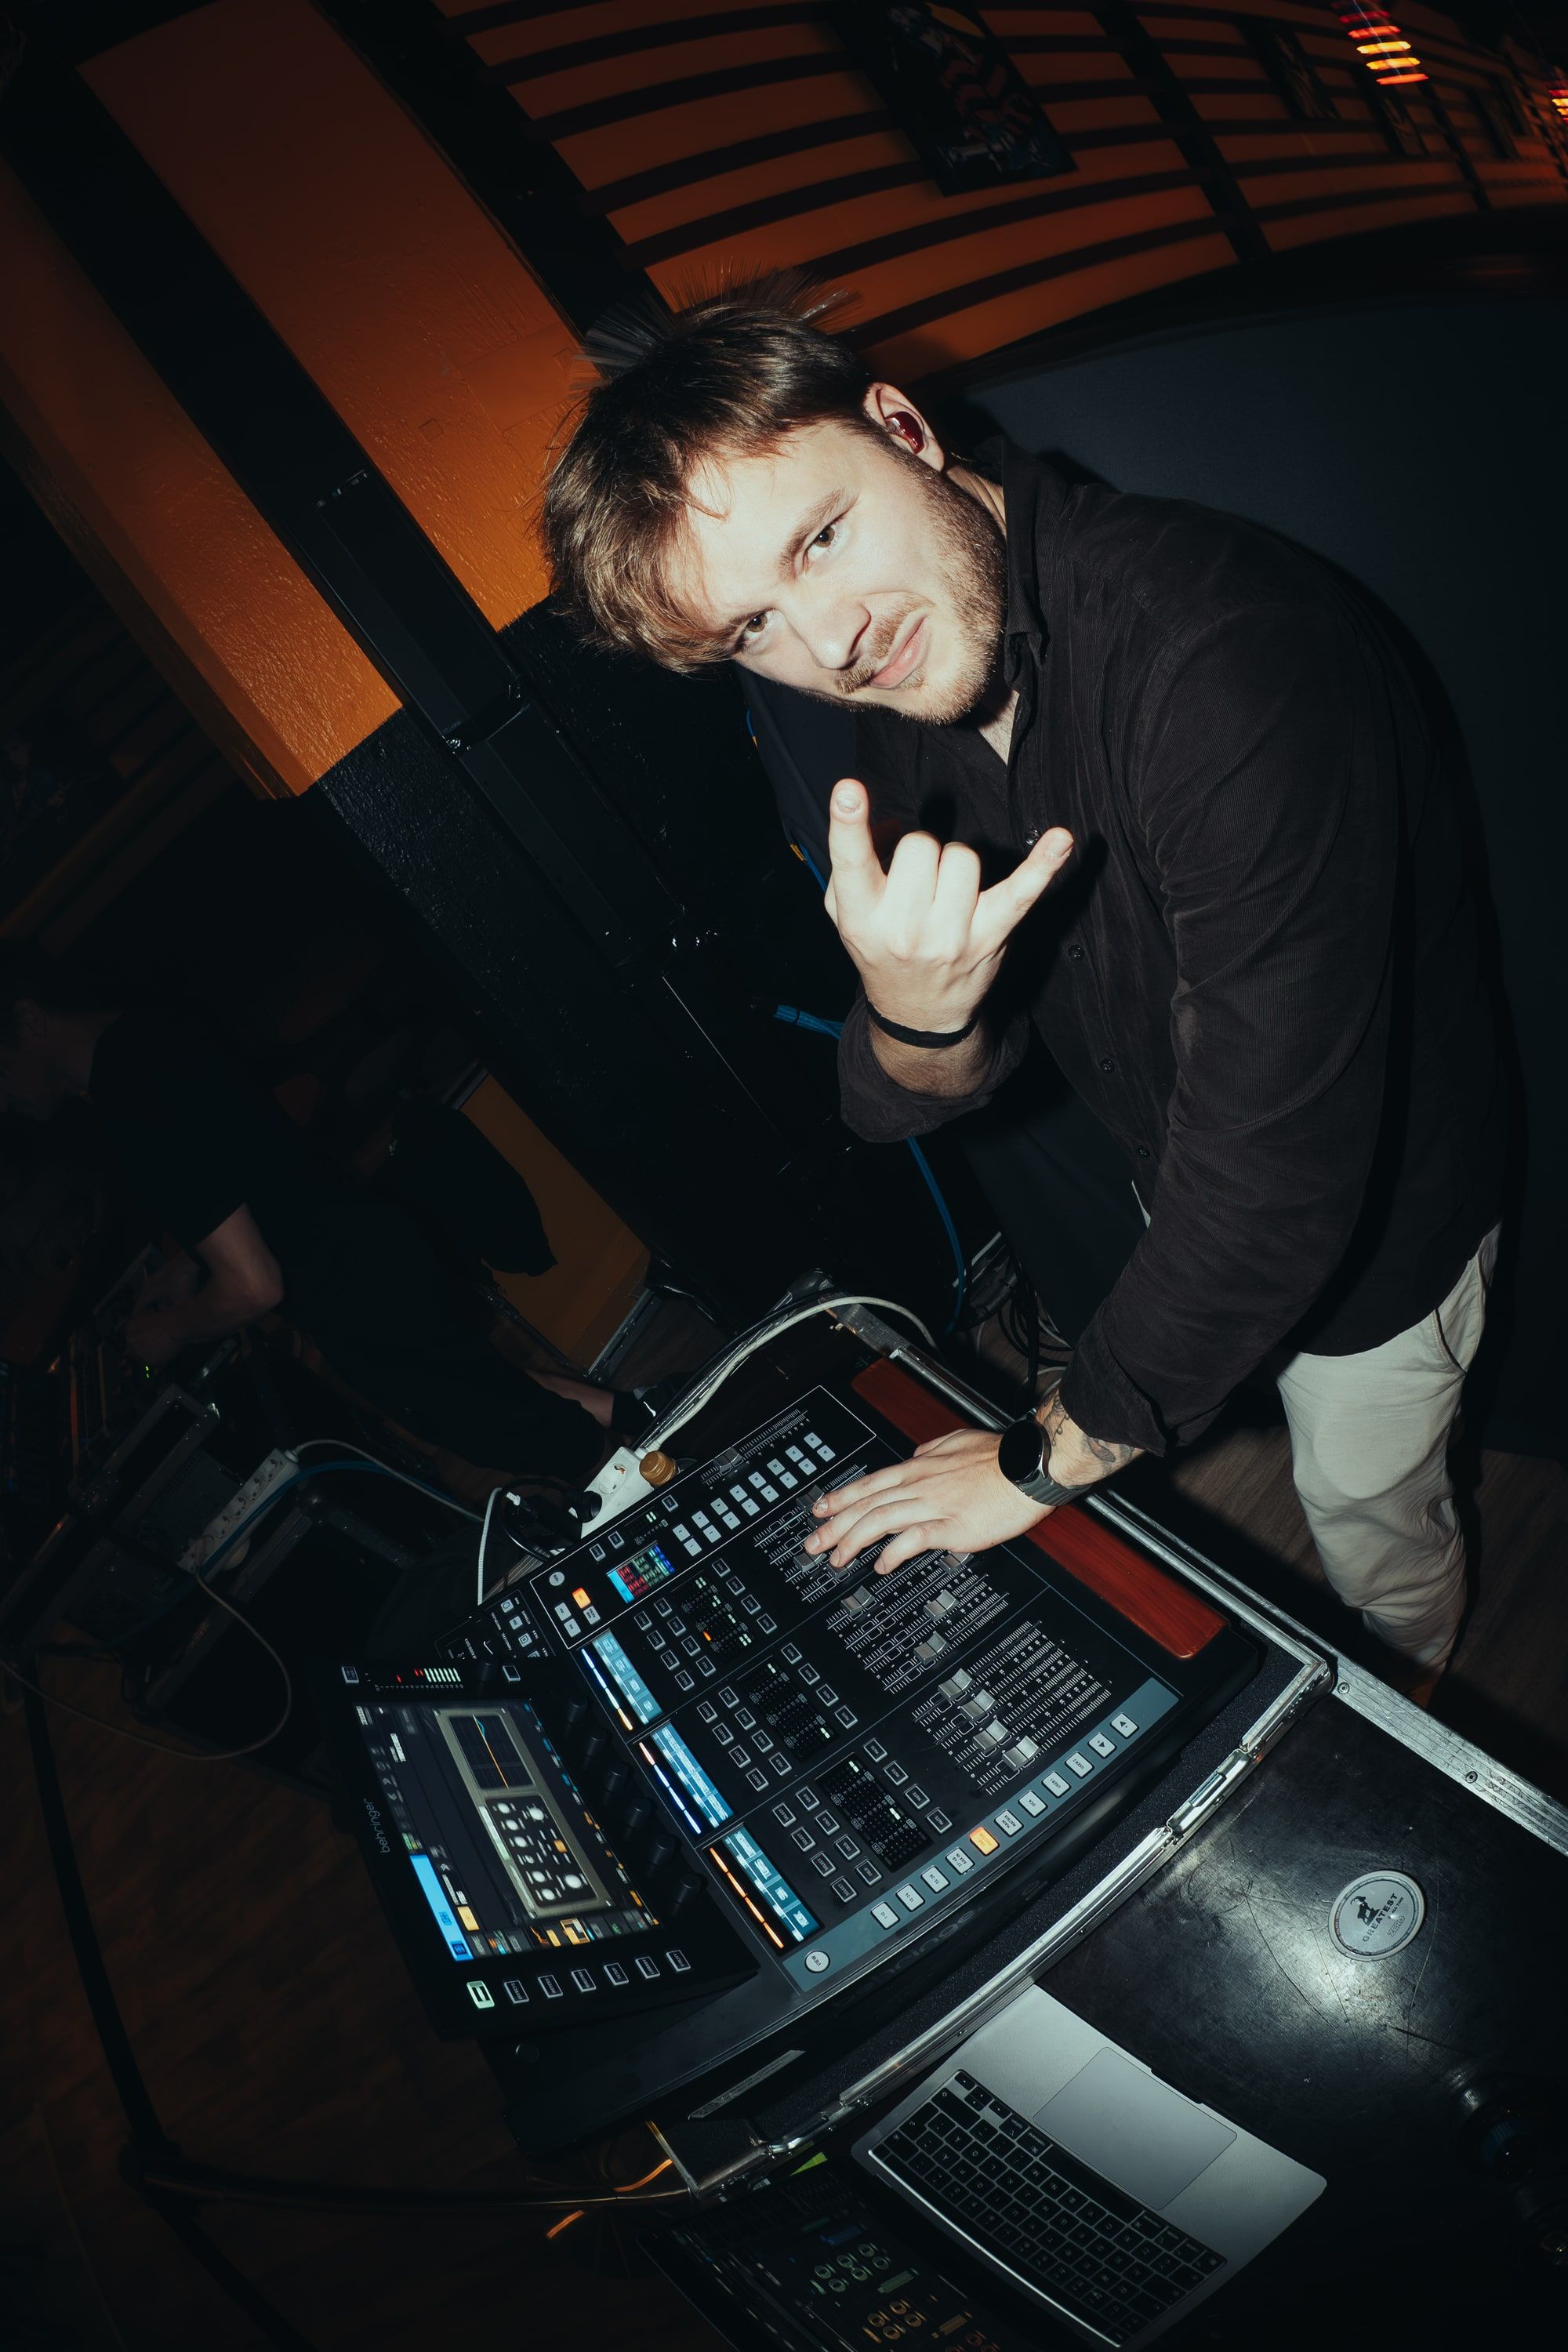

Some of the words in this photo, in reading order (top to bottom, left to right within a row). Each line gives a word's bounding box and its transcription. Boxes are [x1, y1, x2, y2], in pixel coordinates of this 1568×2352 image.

[779, 1809, 789, 1820] SELECT
[363, 1798, 390, 1852] behringer
[797, 1833, 808, 1845] SELECT
[818, 1859, 828, 1871] SELECT
[838, 1884, 849, 1896] SELECT
[1363, 1893, 1398, 1941] GREATEST
[1387, 1915, 1405, 1936] ZERO
[811, 1956, 821, 1966] VIEW
